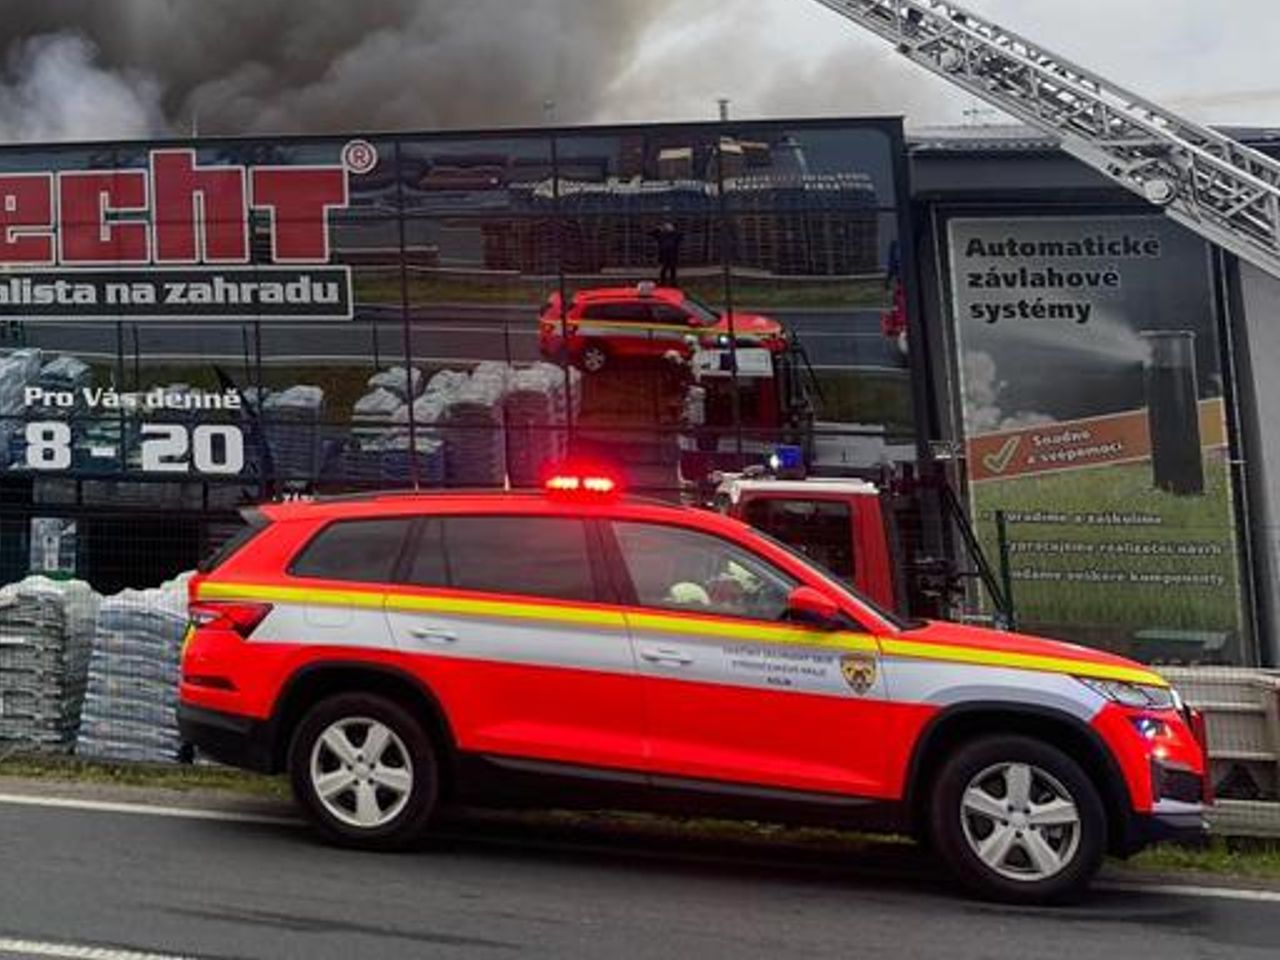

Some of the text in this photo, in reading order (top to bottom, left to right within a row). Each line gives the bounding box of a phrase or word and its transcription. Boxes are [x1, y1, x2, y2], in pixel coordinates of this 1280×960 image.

[965, 235, 1160, 257] Automatické
[967, 265, 1119, 288] závlahové
[106, 281, 157, 305] na
[164, 277, 339, 305] zahradu
[970, 297, 1091, 324] systémy
[24, 386, 242, 409] Pro Vás denně
[25, 422, 71, 469] 8
[140, 424, 244, 474] 20
